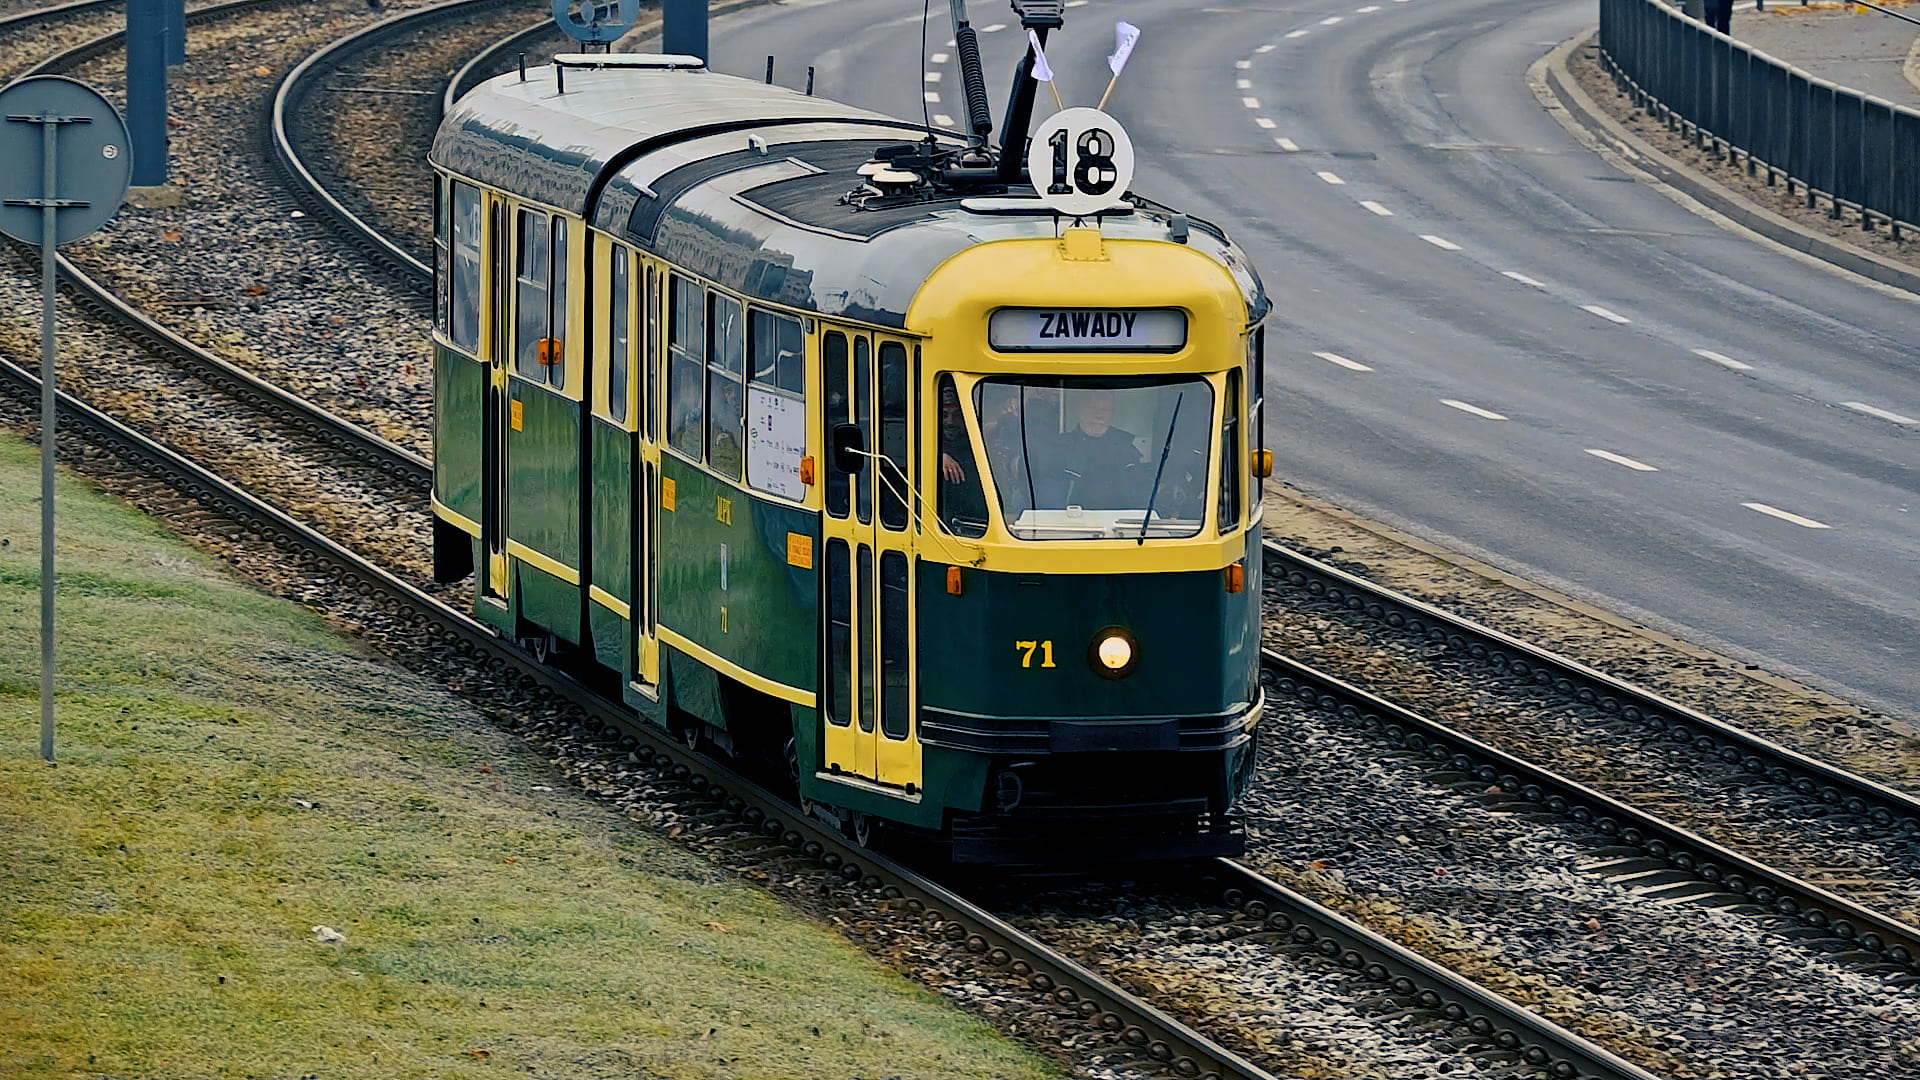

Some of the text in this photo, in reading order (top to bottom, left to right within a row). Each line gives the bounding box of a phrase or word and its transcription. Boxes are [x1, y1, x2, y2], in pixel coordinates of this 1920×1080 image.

[1047, 128, 1117, 195] 18
[1039, 312, 1137, 338] ZAWADY
[1015, 640, 1056, 668] 71
